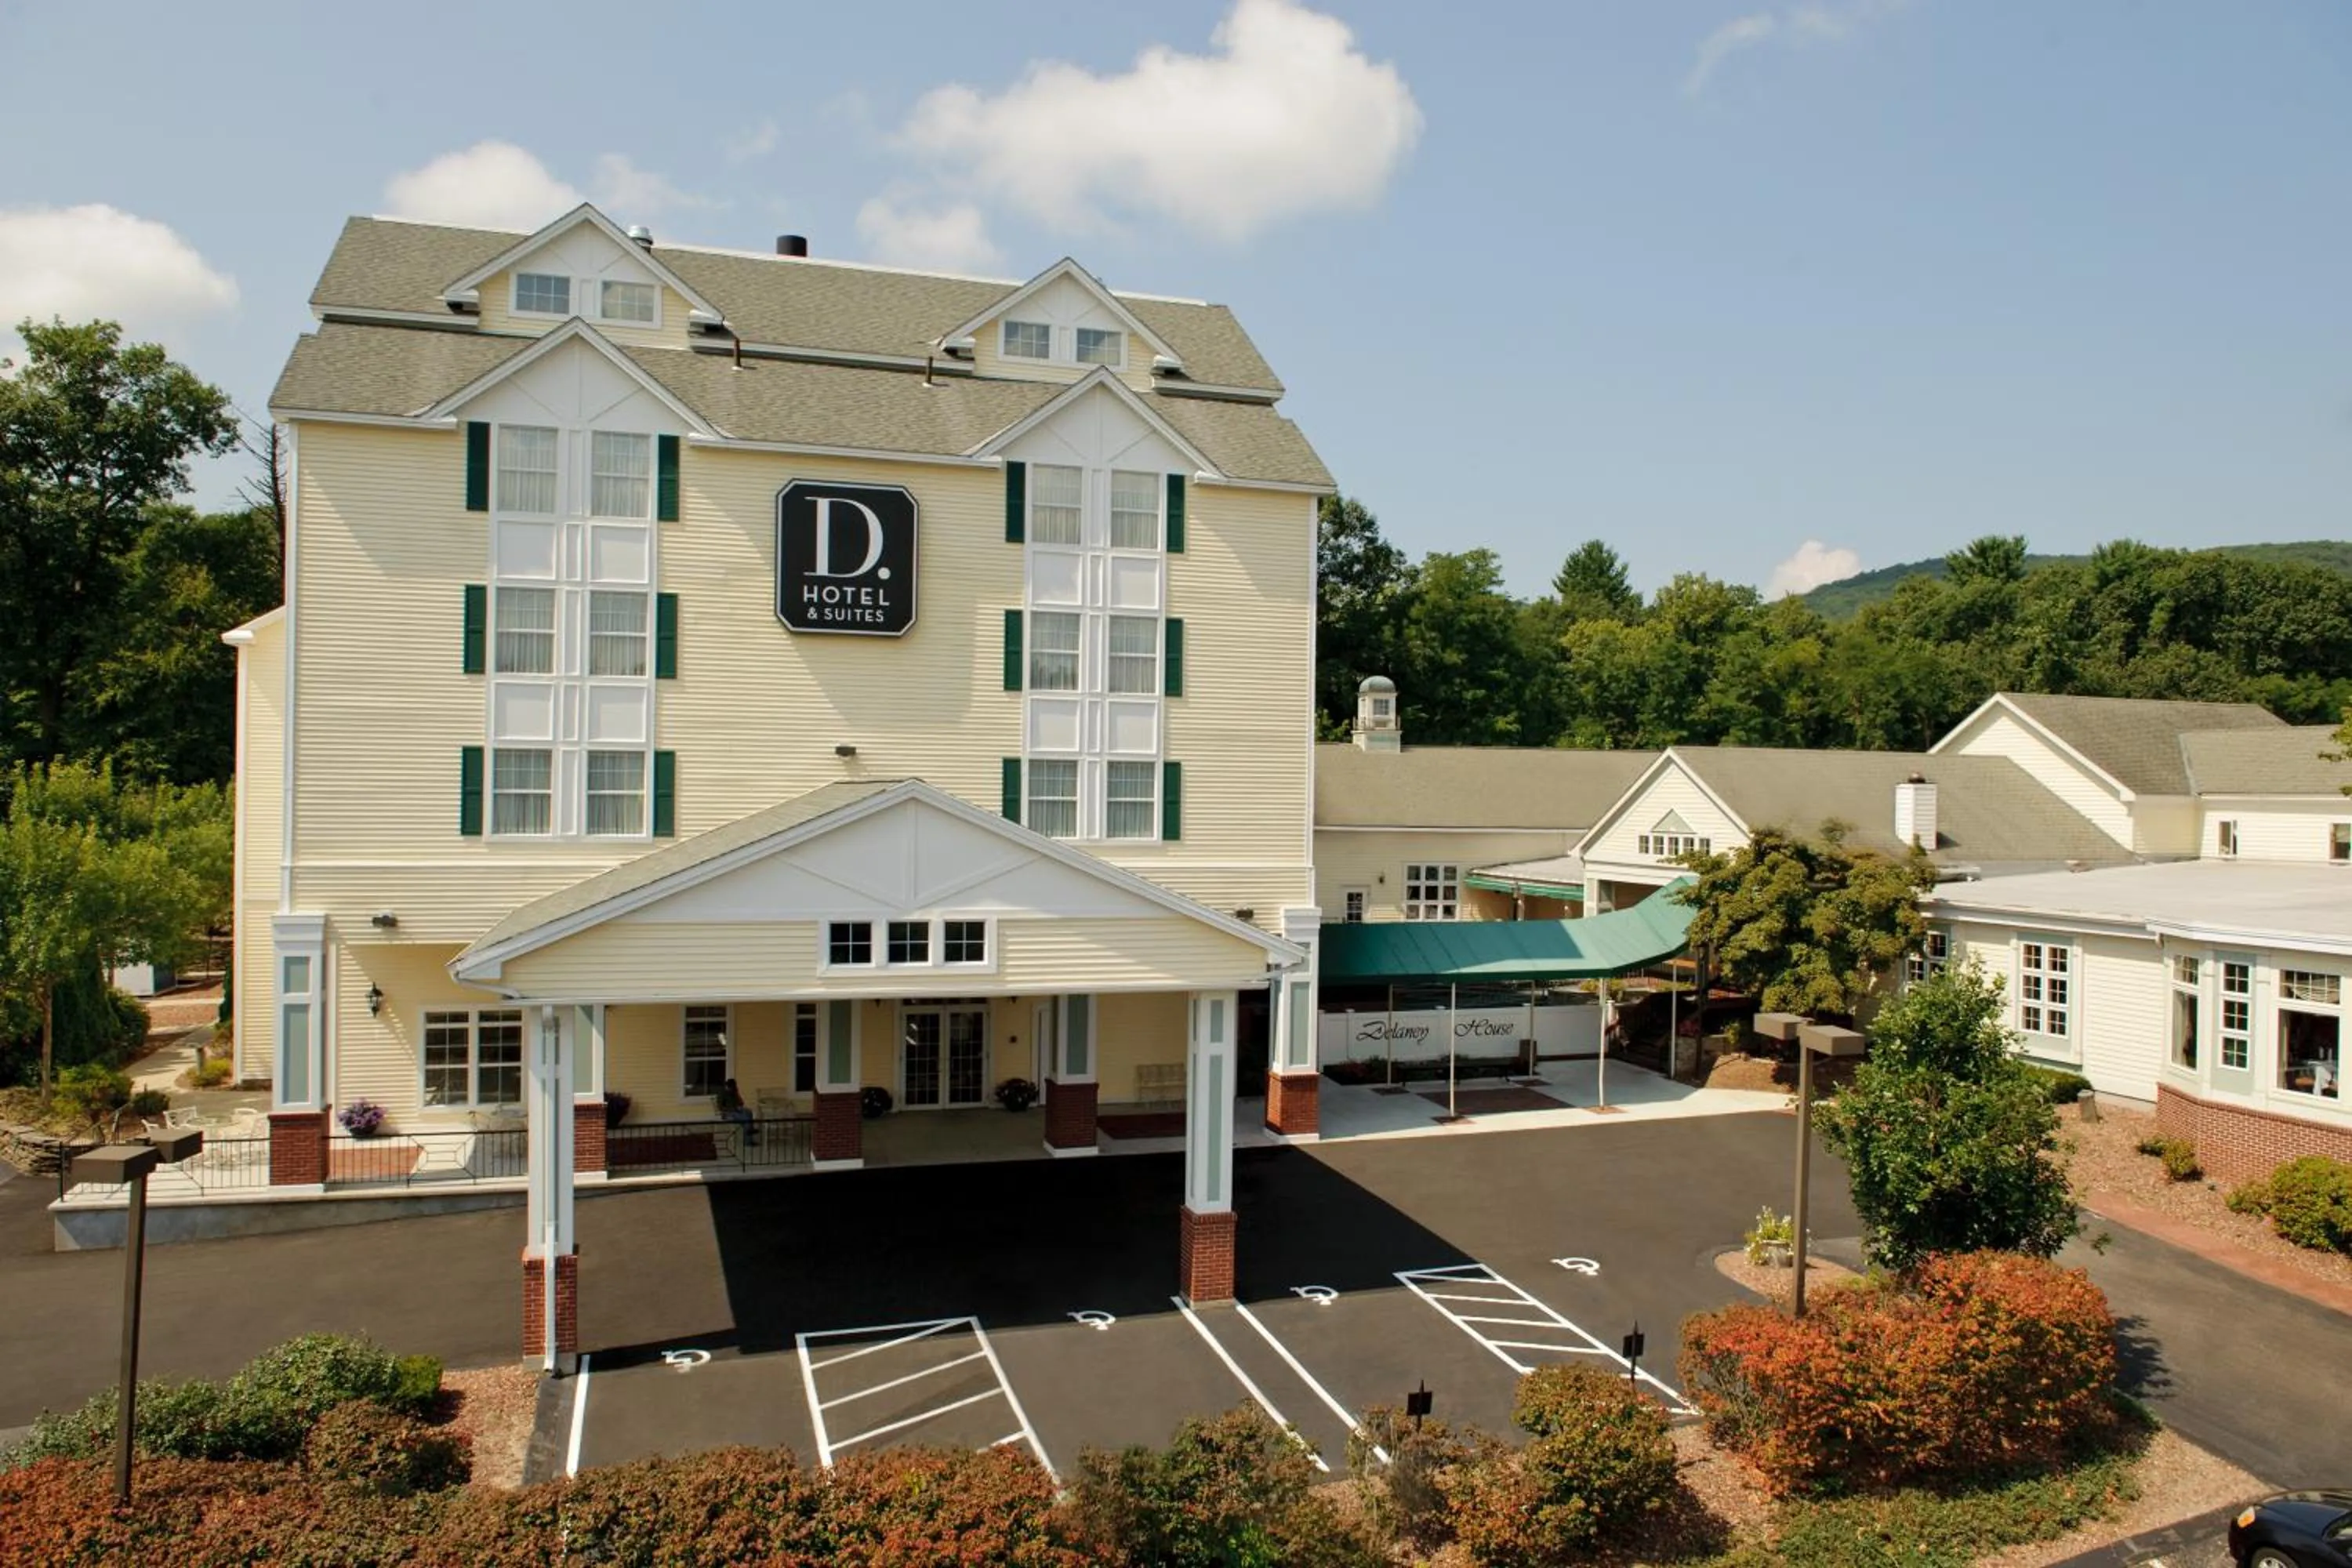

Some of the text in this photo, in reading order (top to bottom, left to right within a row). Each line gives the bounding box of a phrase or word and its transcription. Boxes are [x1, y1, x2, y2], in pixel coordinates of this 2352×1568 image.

[803, 585, 890, 606] HOTEL
[807, 607, 884, 622] & SUITES
[1455, 1019, 1514, 1036] House
